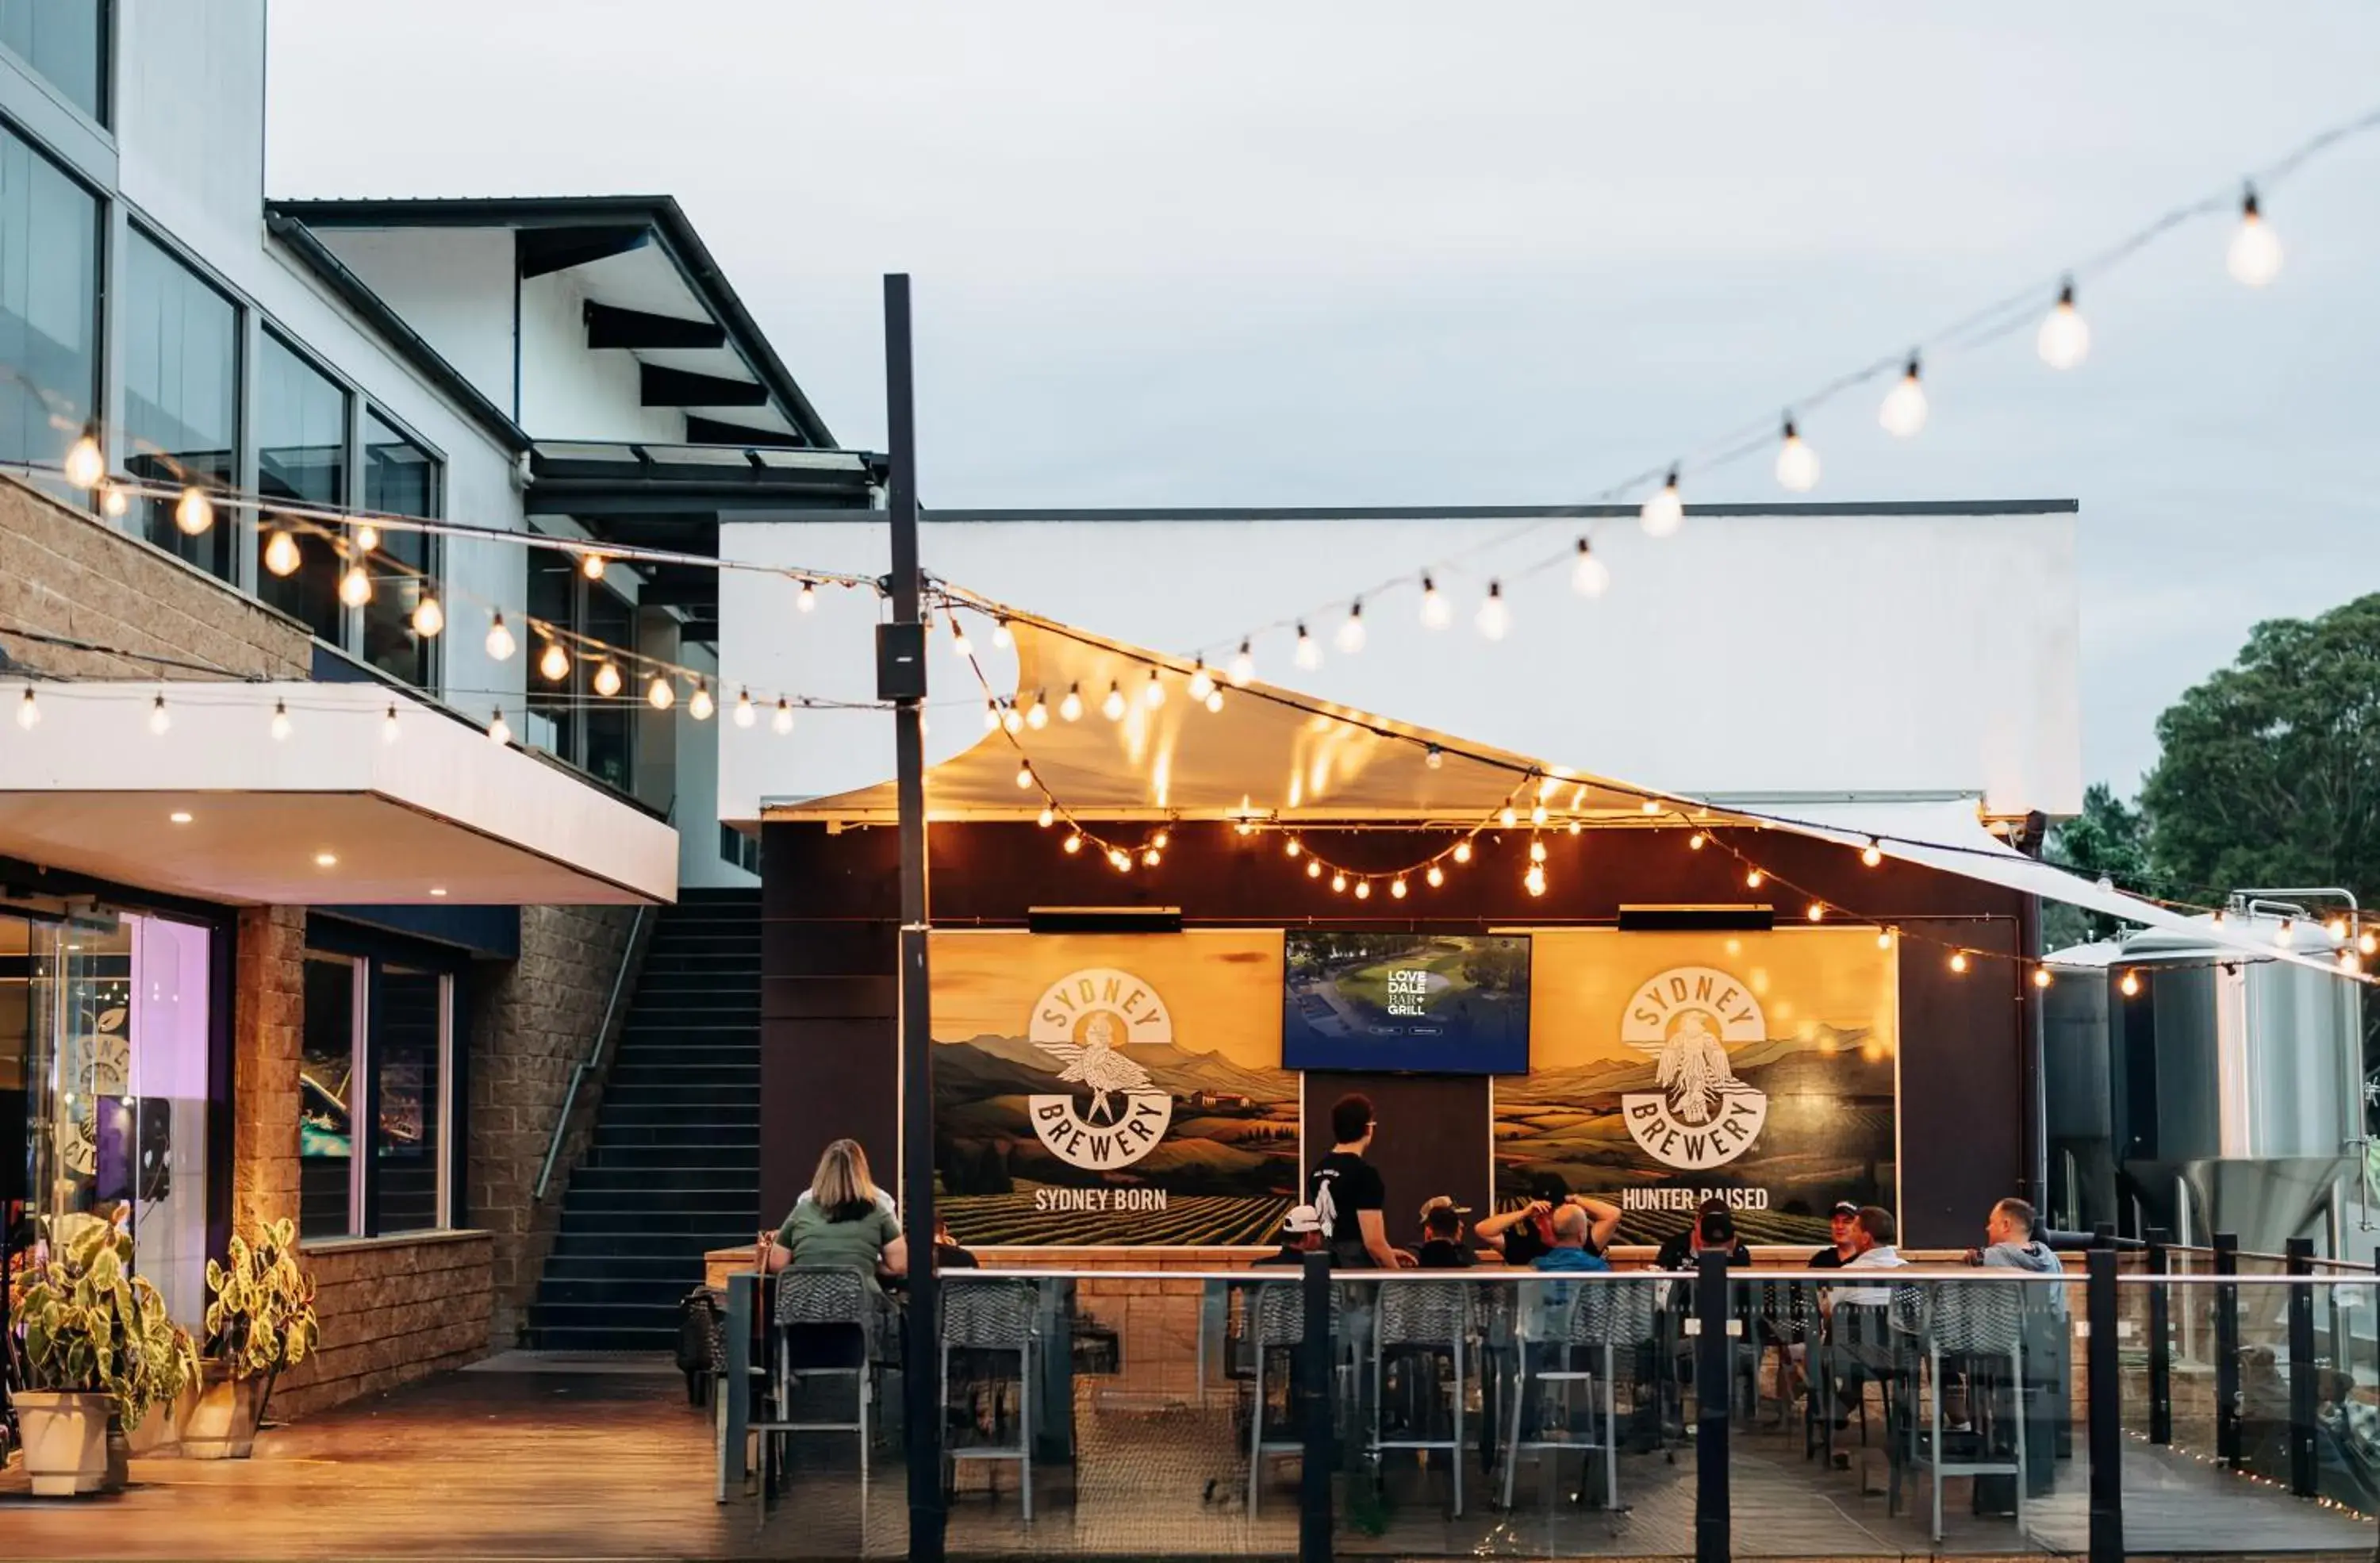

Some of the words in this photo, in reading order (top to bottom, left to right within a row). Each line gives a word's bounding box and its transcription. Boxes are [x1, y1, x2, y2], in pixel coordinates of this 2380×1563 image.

[1388, 970, 1427, 981] LOVE
[1388, 982, 1426, 993] DALE
[1042, 977, 1161, 1027] SYDNEY
[1388, 1005, 1426, 1016] GRILL
[1634, 975, 1754, 1026] SYDNEY
[1038, 1103, 1162, 1162] BREWERY
[1631, 1101, 1757, 1162] BREWERY
[1035, 1189, 1108, 1211] SYDNEY
[1115, 1189, 1167, 1211] BORN
[1622, 1187, 1695, 1211] HUNTER
